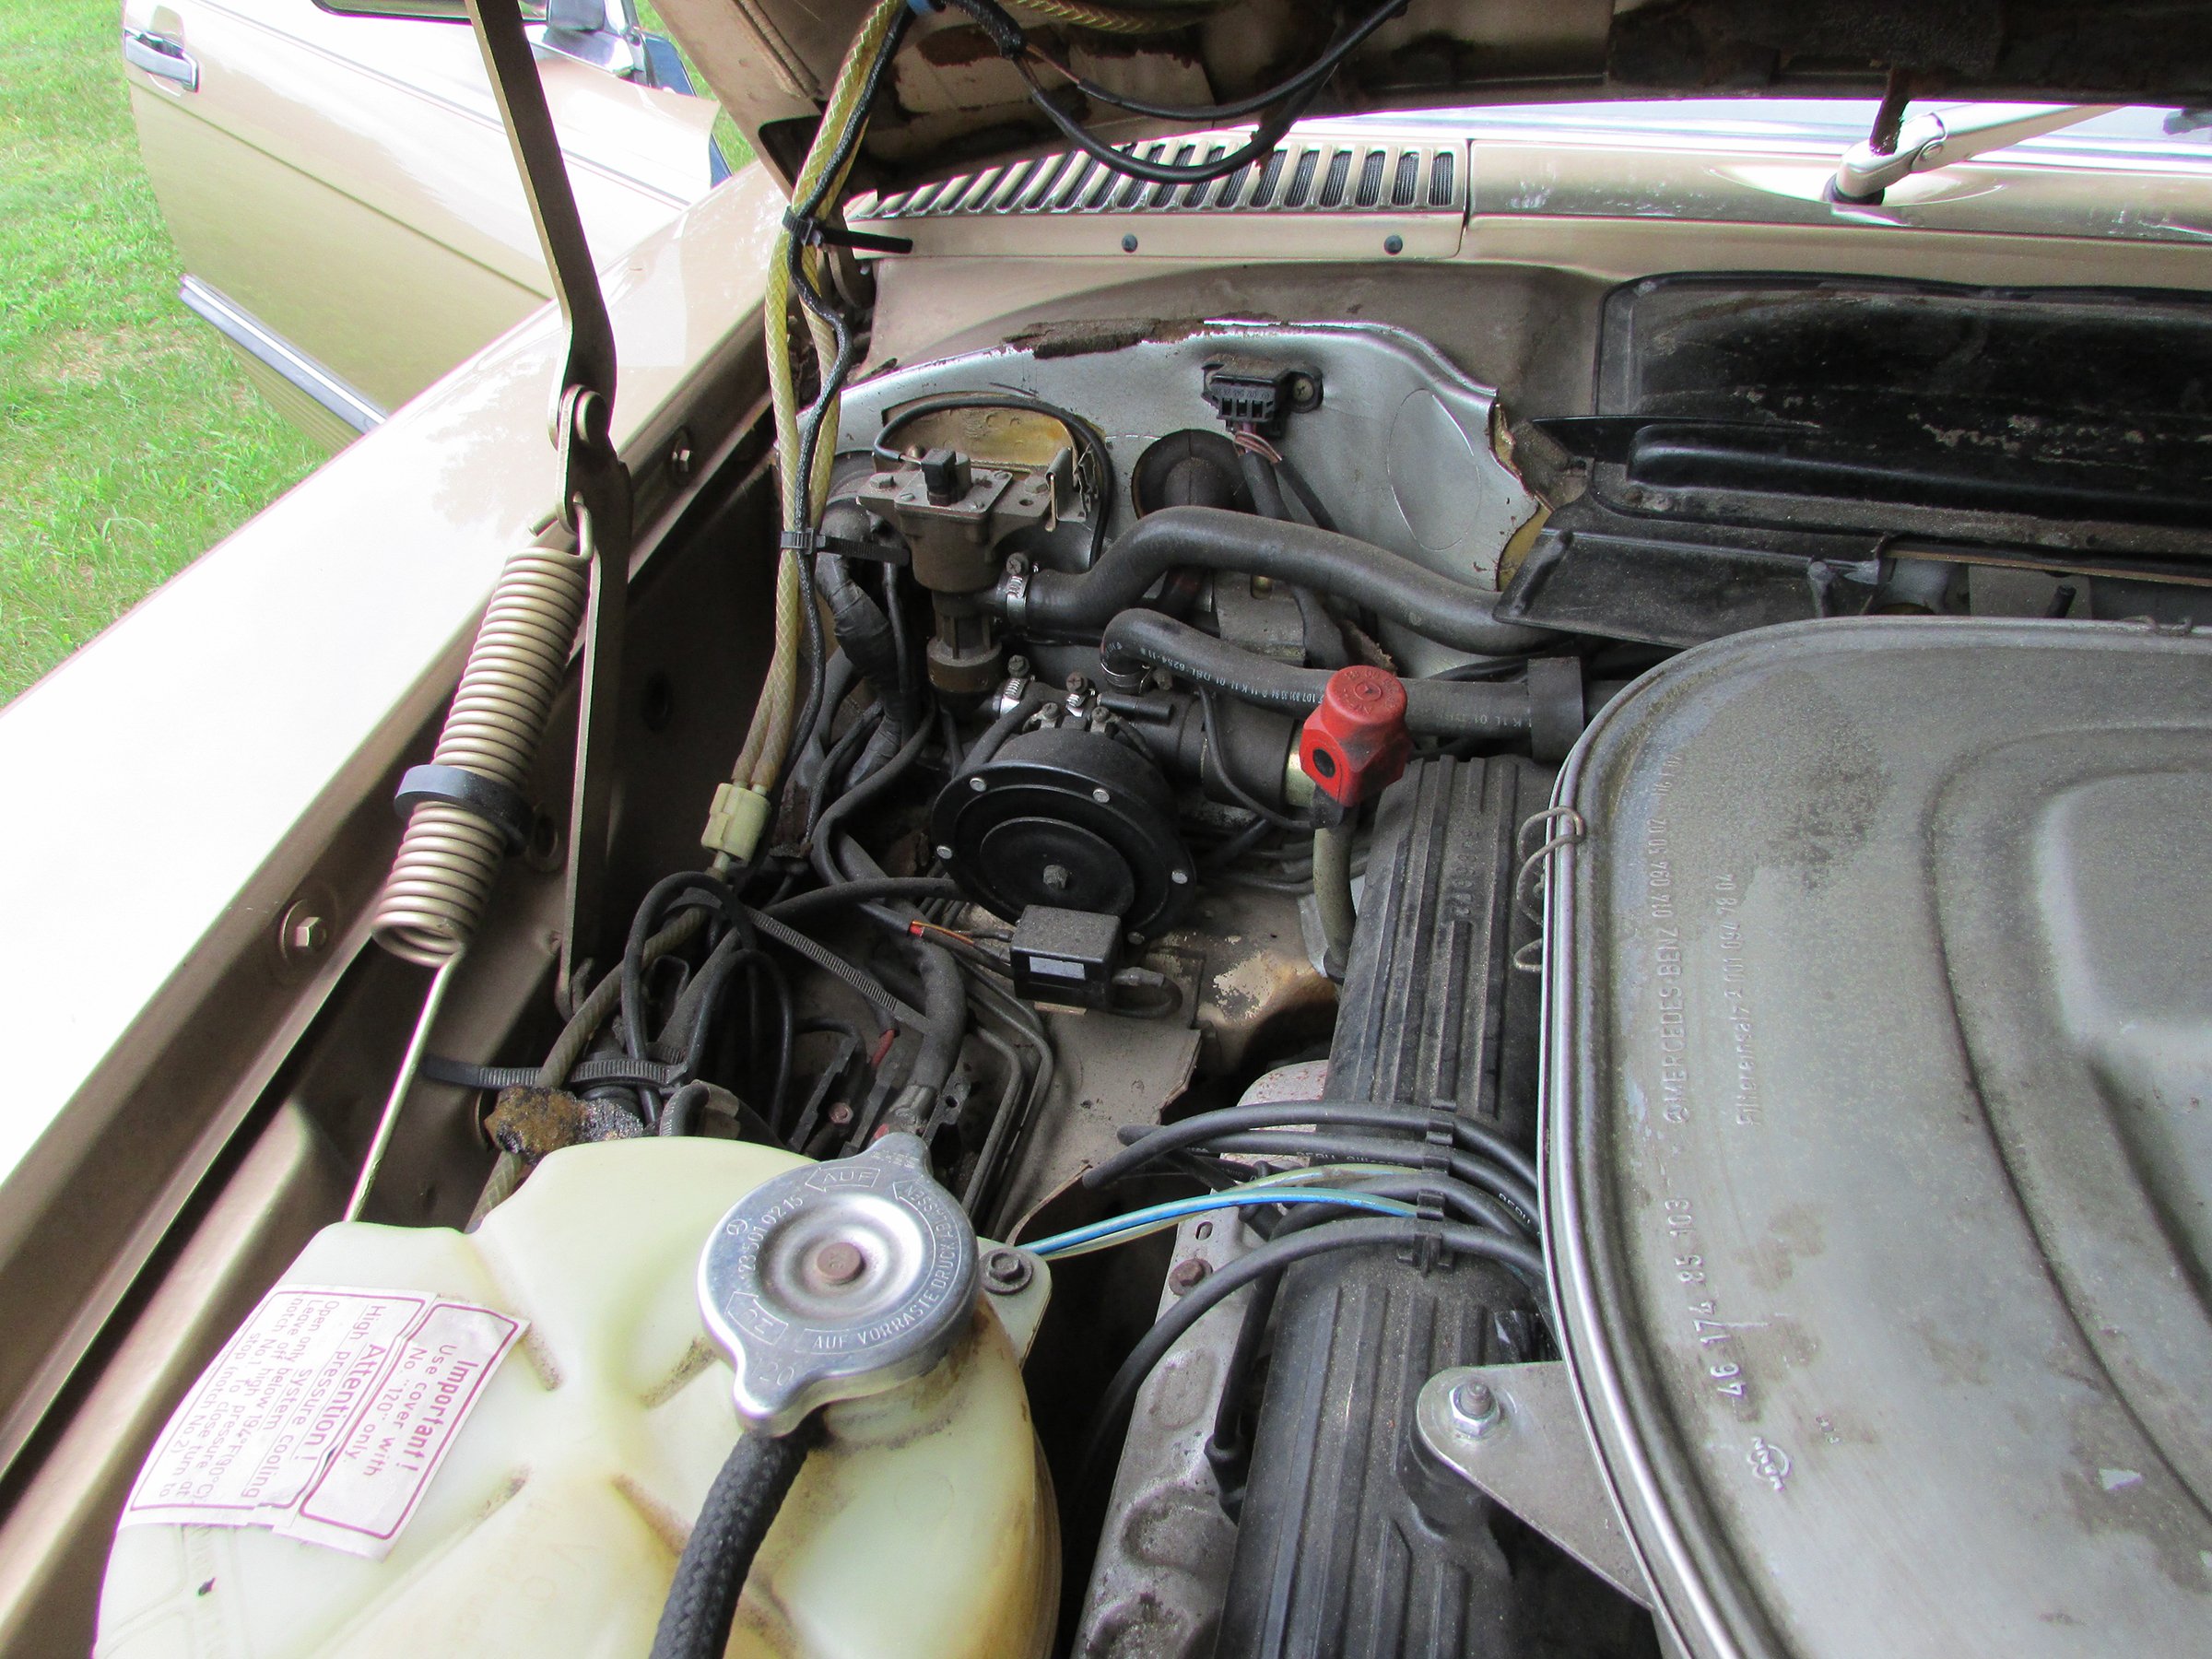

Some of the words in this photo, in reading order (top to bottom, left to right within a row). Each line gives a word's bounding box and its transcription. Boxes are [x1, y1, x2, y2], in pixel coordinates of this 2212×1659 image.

[822, 1171, 874, 1183] AUF
[783, 1196, 804, 1209] 15
[1665, 1198, 1696, 1238] 103
[1674, 1253, 1705, 1283] 85
[813, 1335, 848, 1349] AUF
[857, 1289, 940, 1344] VORRASTE
[931, 1244, 957, 1288] DRUCK
[271, 1298, 303, 1333] notch
[288, 1300, 324, 1336] Leave
[307, 1300, 339, 1333] Open
[350, 1305, 385, 1342] High
[1688, 1300, 1732, 1347] 174
[234, 1333, 261, 1360] stop
[270, 1342, 288, 1361] off
[286, 1336, 312, 1363] only
[424, 1344, 457, 1375] Use
[201, 1366, 238, 1410] (notch
[243, 1368, 274, 1397] high
[255, 1368, 293, 1408] below
[292, 1350, 350, 1426] pressure
[751, 1358, 794, 1386] 120
[1710, 1362, 1746, 1397] 46
[263, 1369, 313, 1430] system
[393, 1382, 428, 1430] cover
[195, 1405, 245, 1469] pressure
[197, 1401, 229, 1438] close
[171, 1445, 203, 1475] turn
[240, 1434, 294, 1499] cooling
[363, 1437, 395, 1477] with
[159, 1482, 177, 1498] to
[175, 1480, 193, 1498] at
